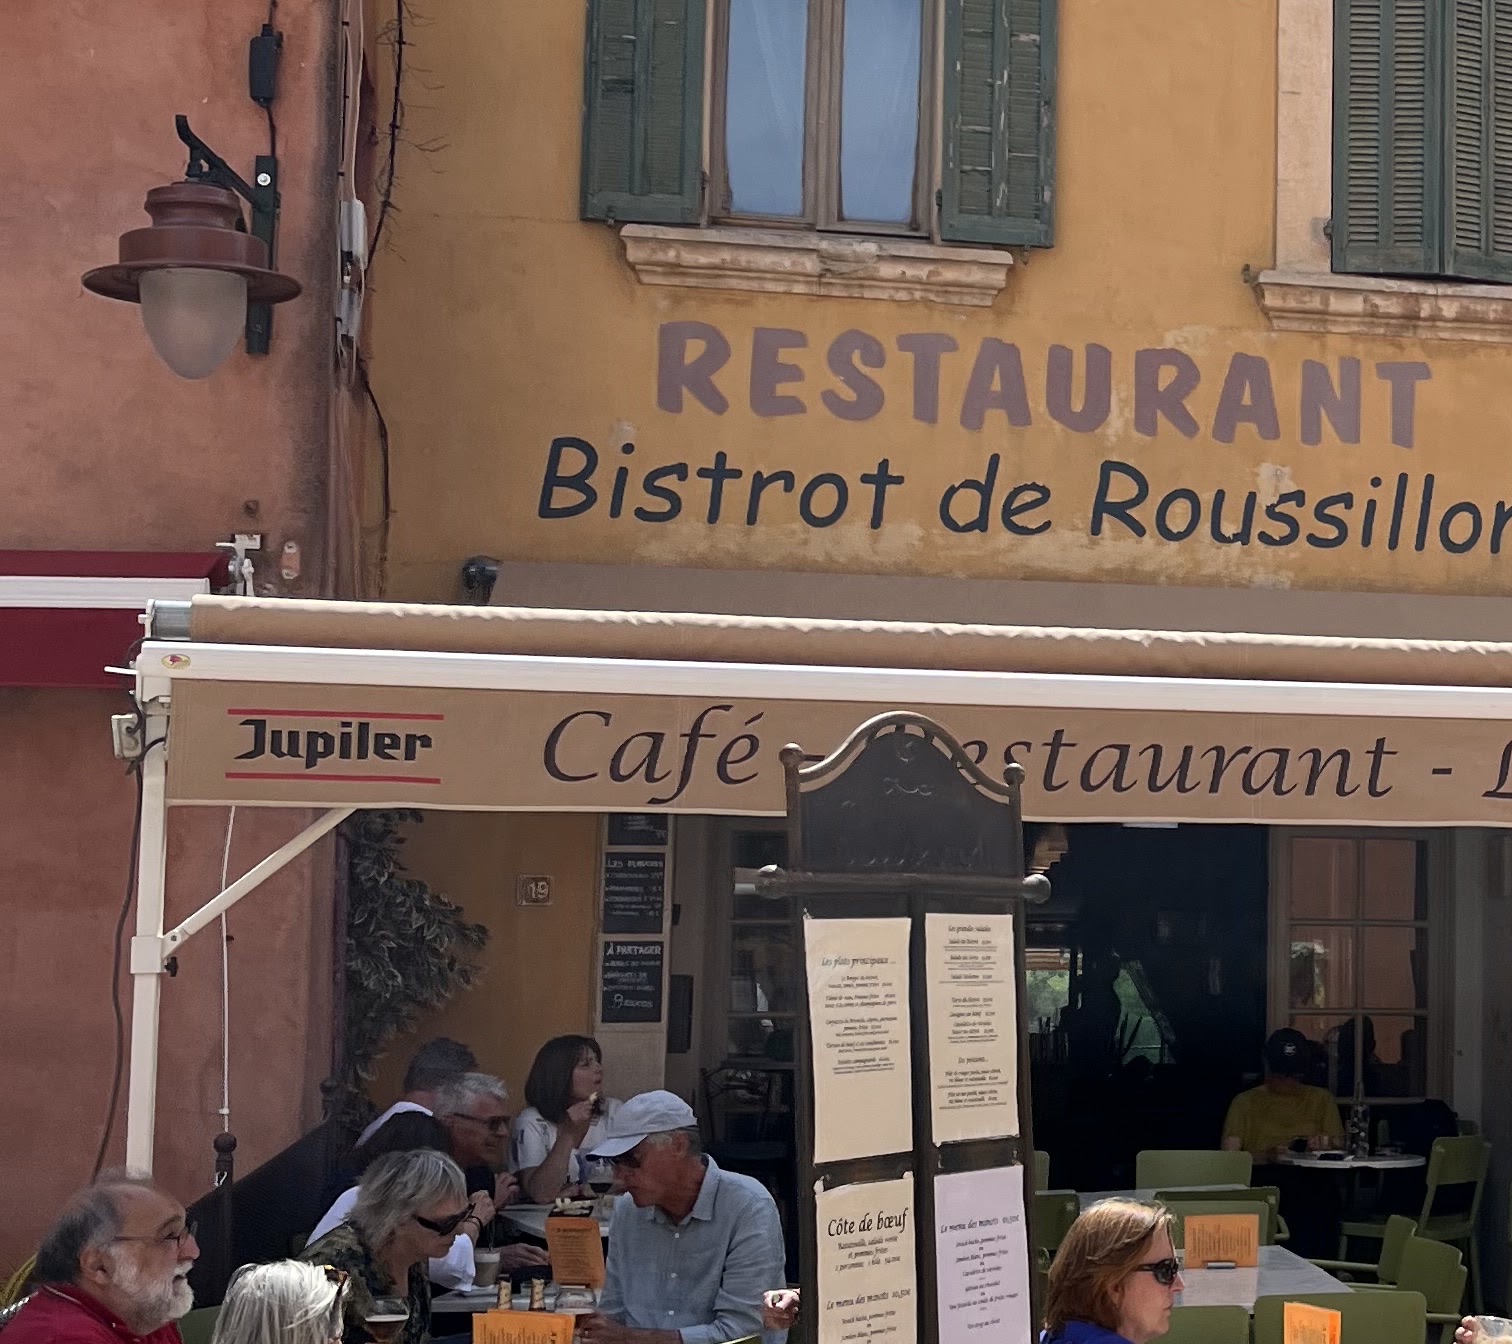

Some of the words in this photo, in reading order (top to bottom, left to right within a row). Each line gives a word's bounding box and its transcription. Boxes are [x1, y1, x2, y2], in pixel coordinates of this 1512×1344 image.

[655, 320, 1433, 449] RESTAURANT
[537, 437, 904, 534] Bistrot
[938, 453, 1052, 537] de
[234, 719, 433, 770] Jupiler
[542, 704, 767, 805] Café
[529, 881, 549, 899] 19
[828, 1217, 855, 1237] Côte
[858, 1212, 873, 1233] de
